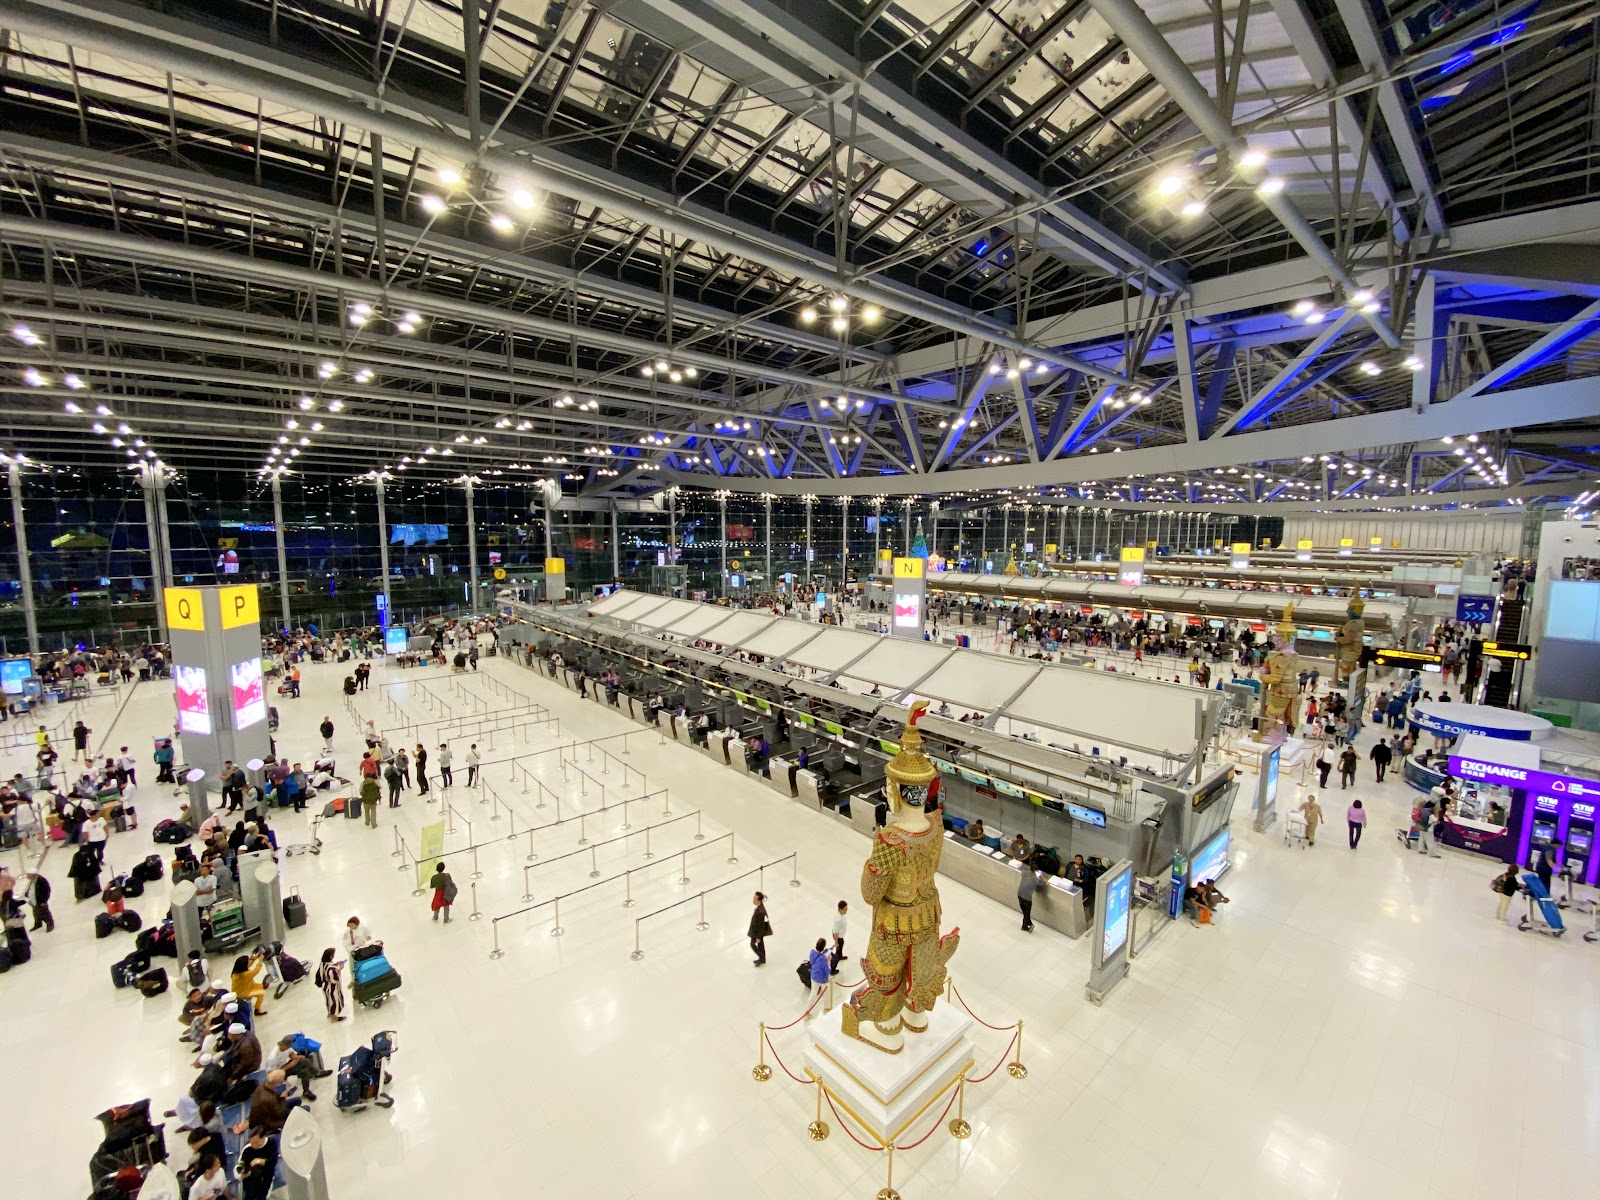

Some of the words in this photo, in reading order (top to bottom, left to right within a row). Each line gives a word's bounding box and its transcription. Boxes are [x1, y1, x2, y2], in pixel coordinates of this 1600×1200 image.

[904, 562, 912, 573] N
[178, 598, 190, 620] Q
[234, 596, 246, 617] P
[1460, 760, 1528, 780] EXCHANGE
[1537, 796, 1558, 805] ATM
[1573, 803, 1594, 813] ATM
